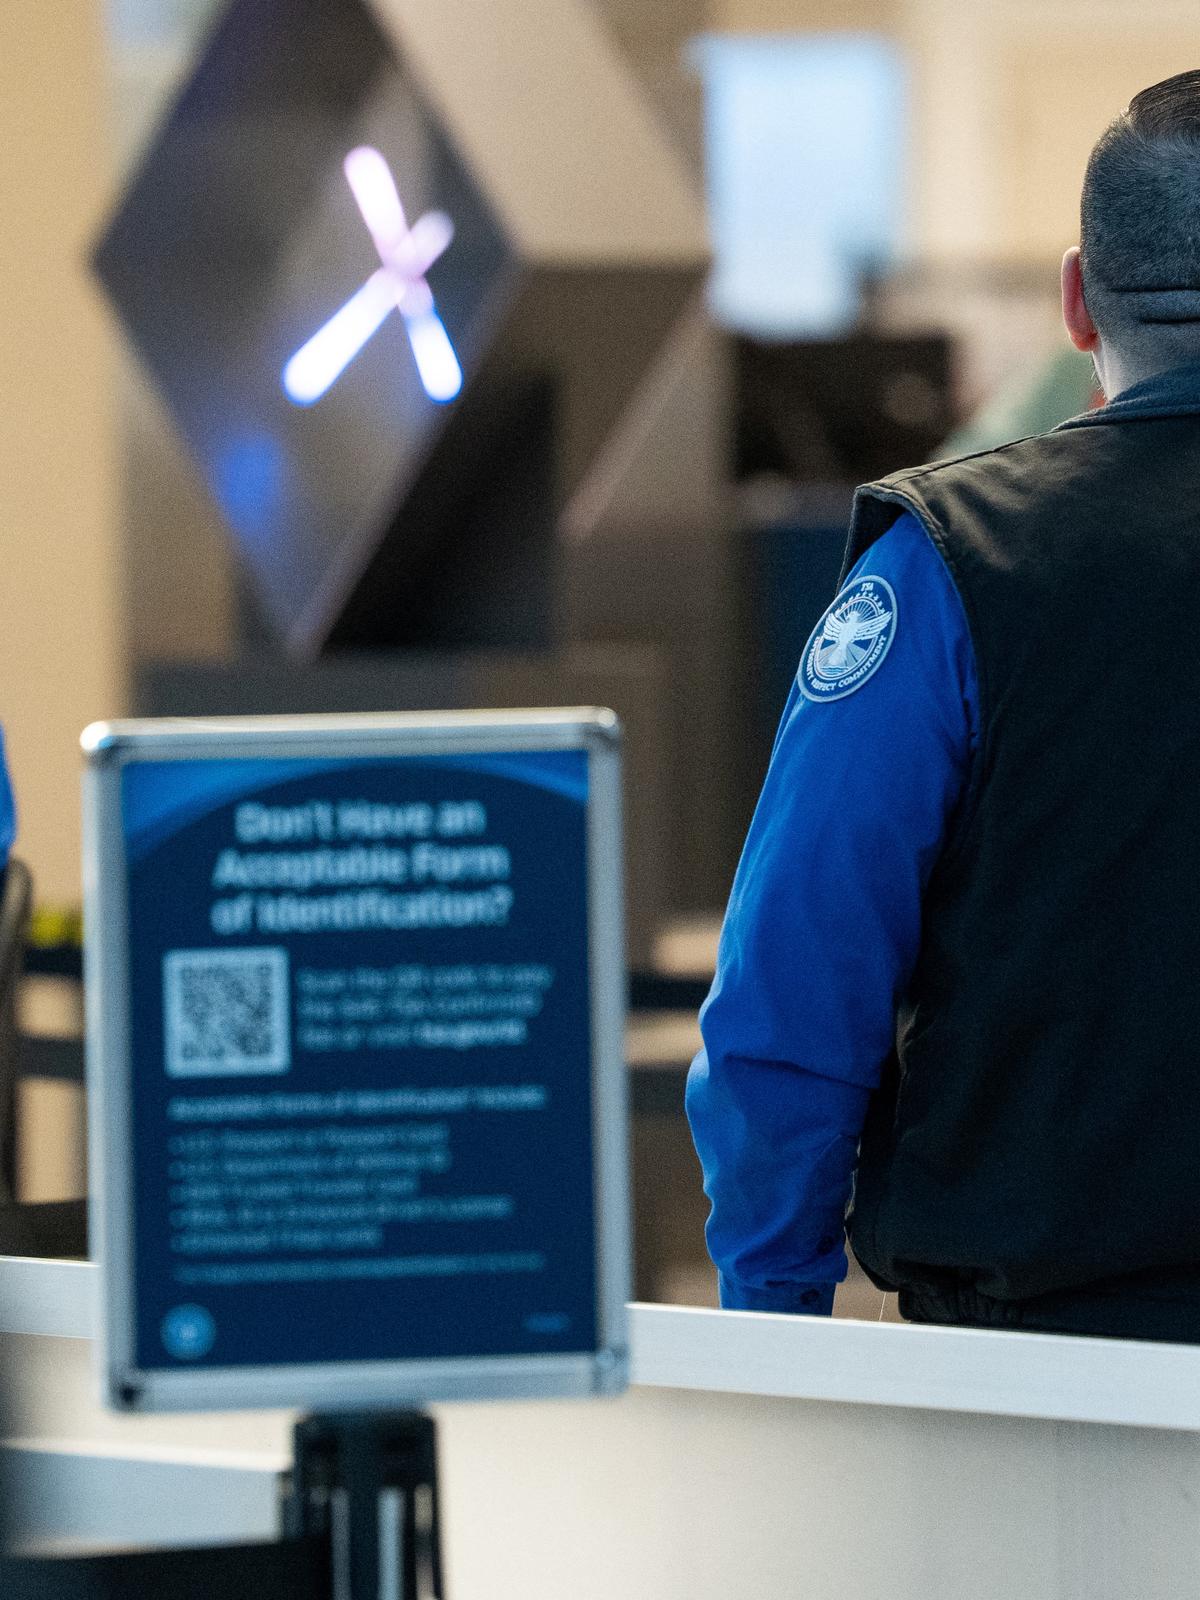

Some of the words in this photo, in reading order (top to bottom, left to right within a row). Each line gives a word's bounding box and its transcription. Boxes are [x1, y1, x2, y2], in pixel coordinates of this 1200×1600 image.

[838, 635, 887, 688] COMMITMENT
[236, 801, 334, 842] Don't
[338, 800, 433, 839] Have
[437, 801, 486, 838] an
[212, 846, 407, 889] Acceptable
[412, 843, 510, 882] Form
[211, 893, 251, 934] of
[257, 886, 513, 933] Identification?
